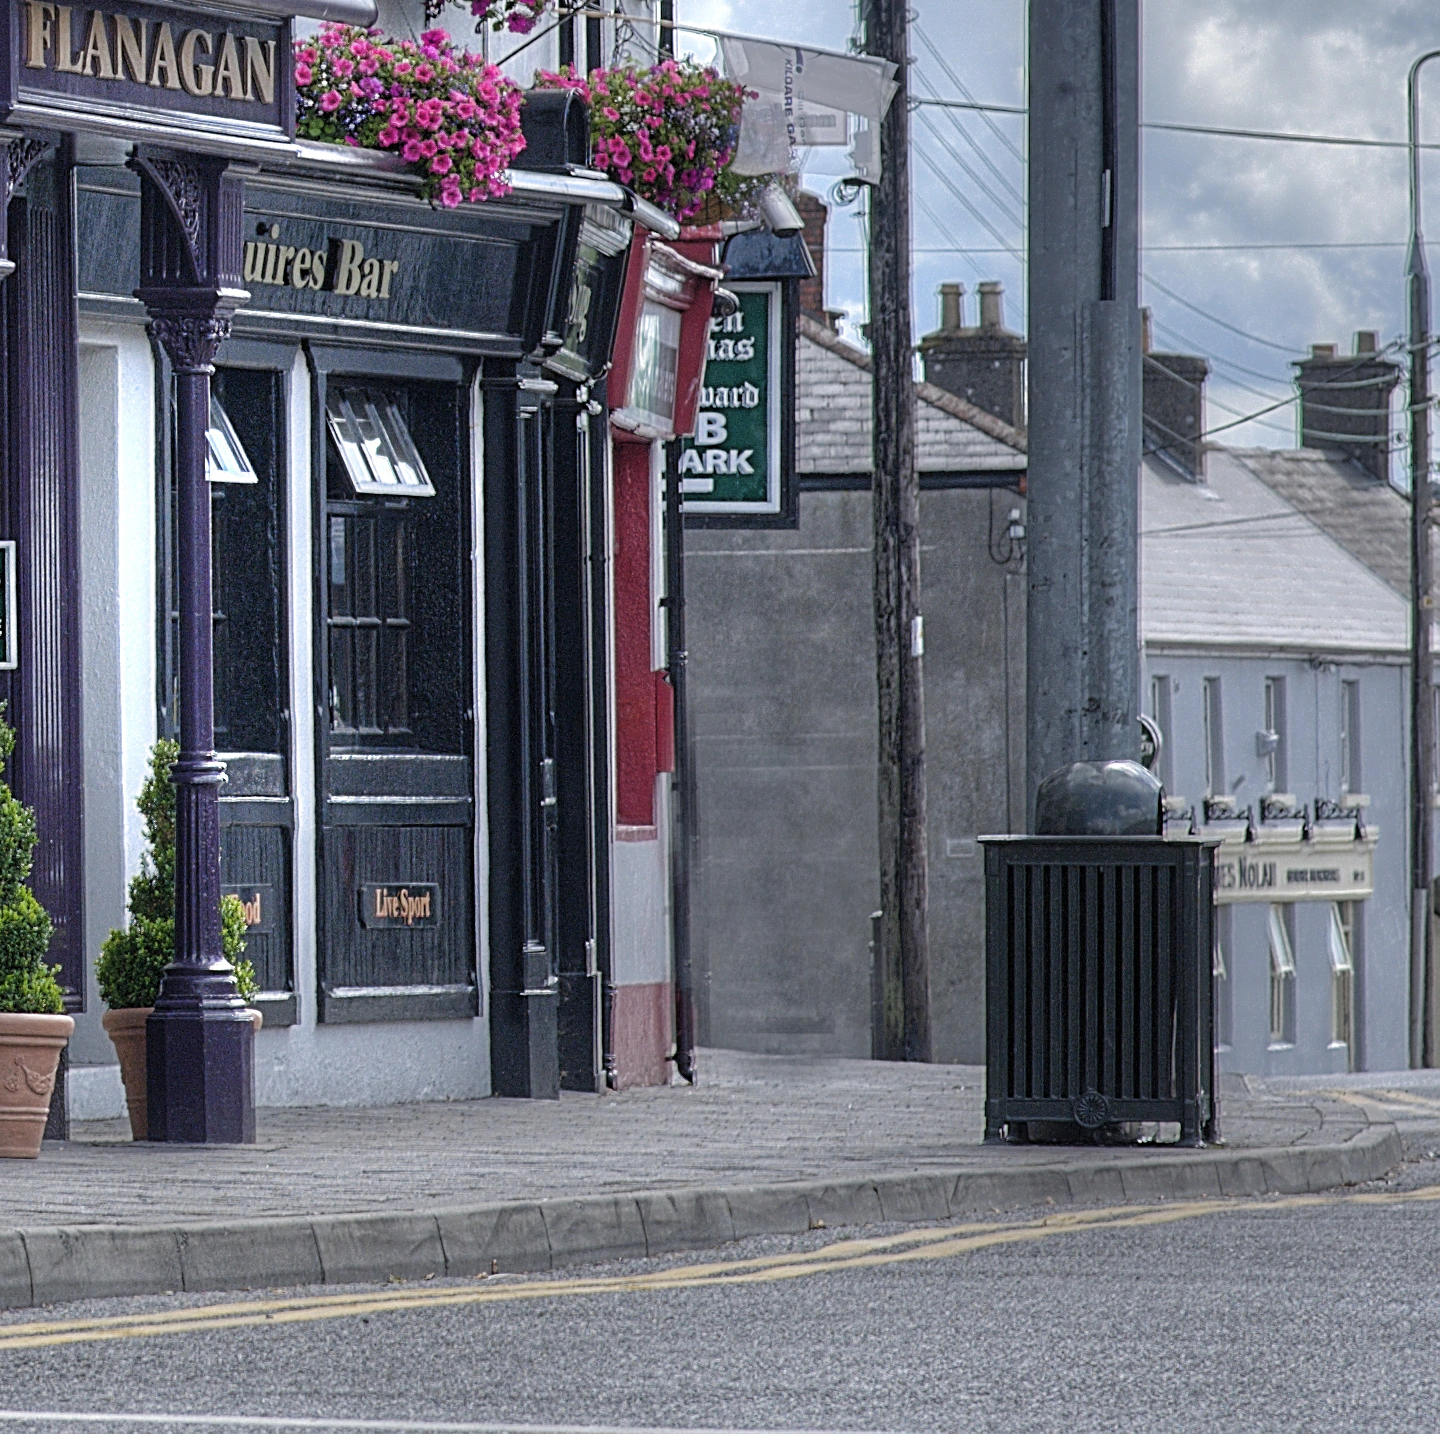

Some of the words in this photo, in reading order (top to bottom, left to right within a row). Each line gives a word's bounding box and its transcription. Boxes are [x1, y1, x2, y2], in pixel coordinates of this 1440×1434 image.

[783, 58, 795, 117] KILDARE
[243, 222, 328, 291] uires
[333, 238, 399, 299] Bar
[709, 310, 745, 334] en
[699, 380, 760, 409] ward
[676, 448, 755, 475] ARK
[375, 888, 399, 918] Live
[399, 888, 431, 926] Sport
